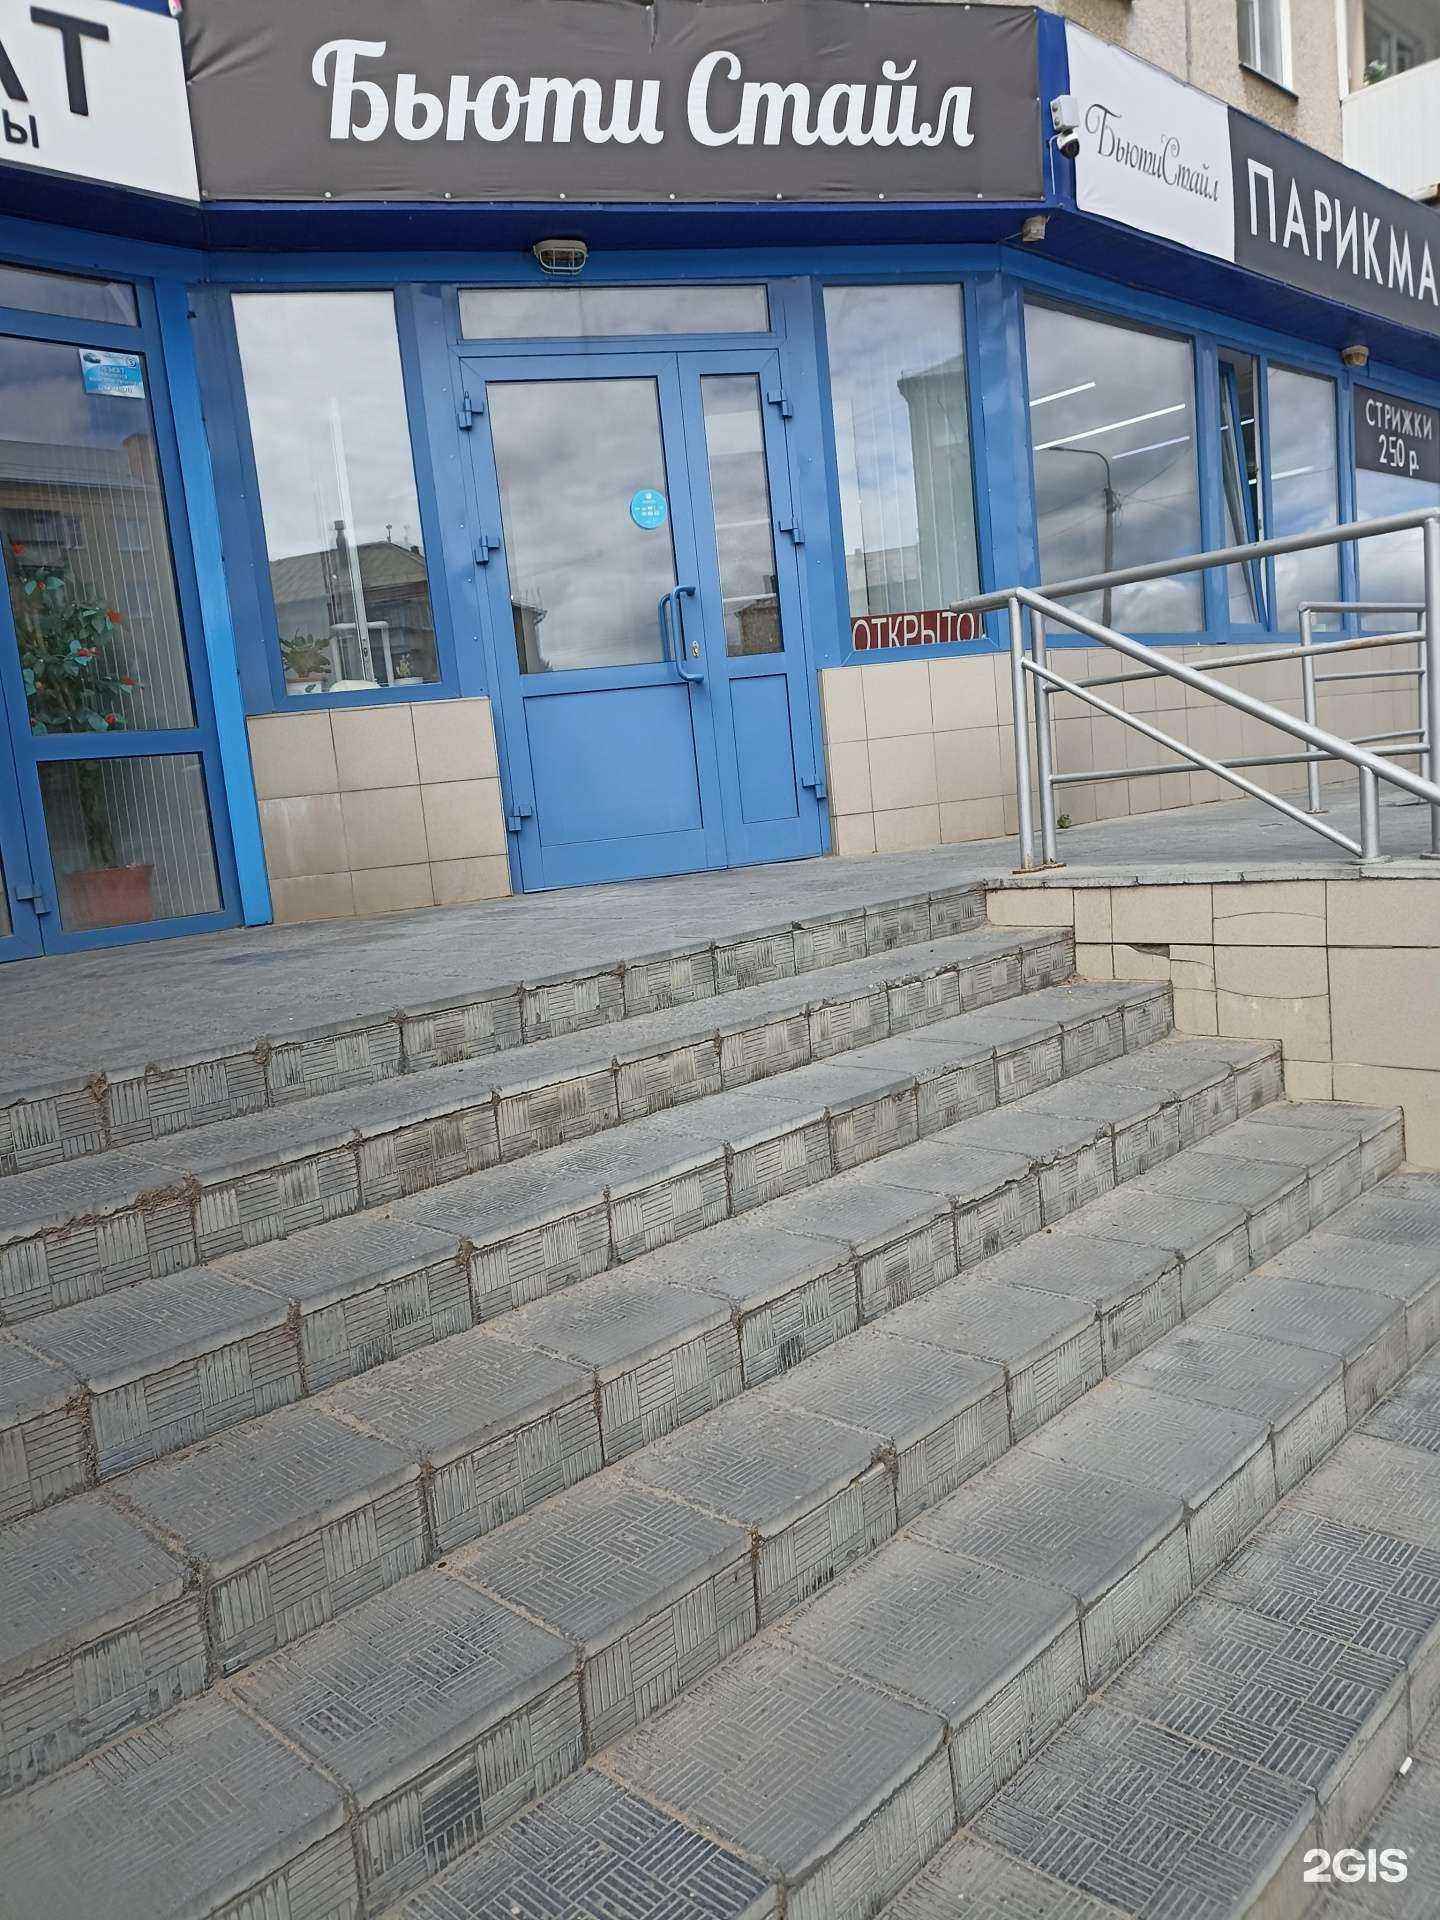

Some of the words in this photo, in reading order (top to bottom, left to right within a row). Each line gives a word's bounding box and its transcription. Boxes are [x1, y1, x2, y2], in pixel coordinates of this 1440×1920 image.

[311, 38, 664, 145] Бьюти
[687, 50, 975, 147] Стайл
[1247, 157, 1440, 307] ПАРИКМА
[1365, 398, 1432, 440] СТРИЖКИ
[1378, 433, 1405, 468] 250
[852, 611, 975, 651] ОТКРЫТО
